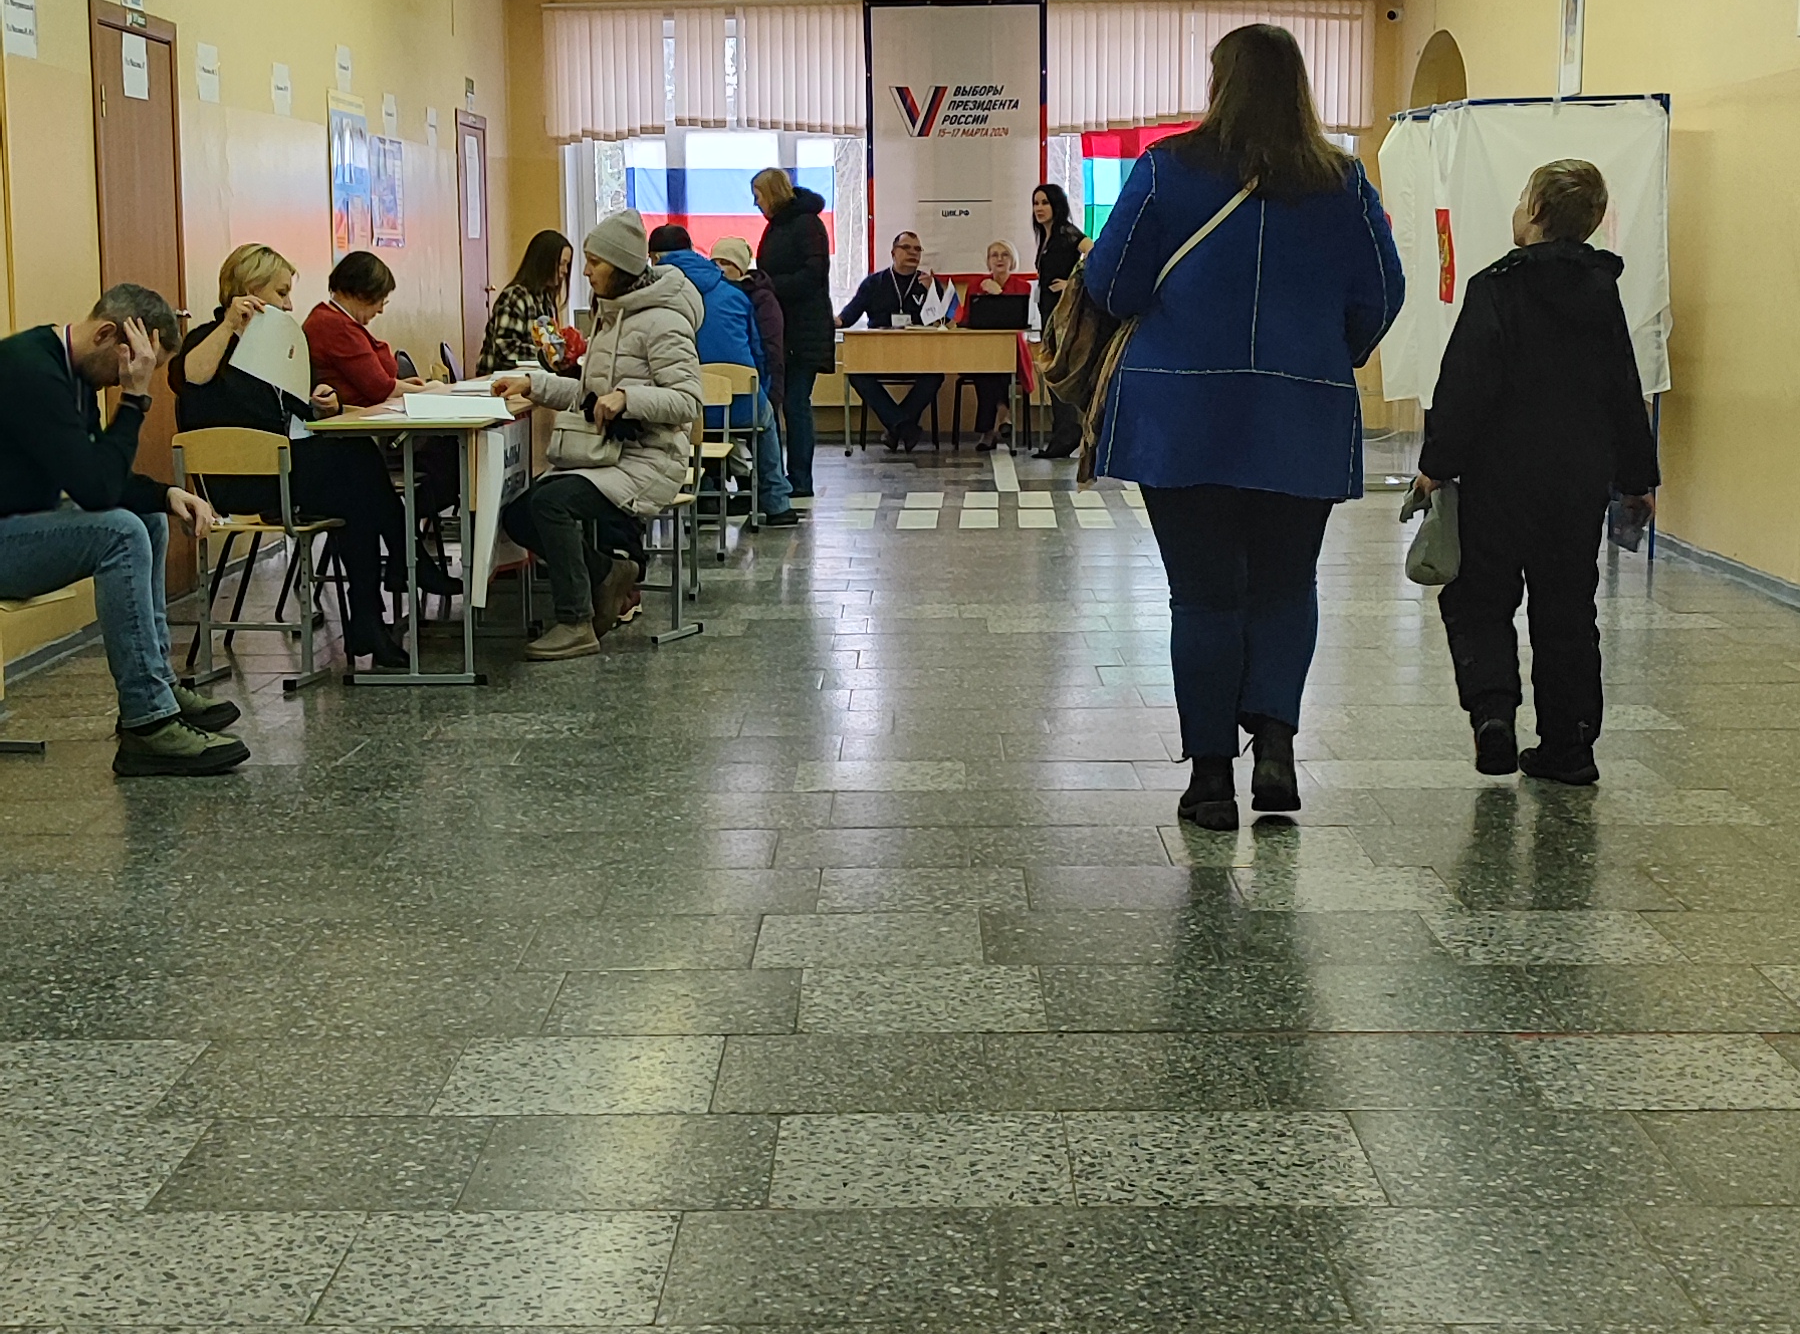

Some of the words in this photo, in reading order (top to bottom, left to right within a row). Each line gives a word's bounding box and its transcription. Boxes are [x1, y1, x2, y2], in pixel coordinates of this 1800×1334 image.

[953, 85, 1004, 97] ВЫБОРЫ
[947, 99, 1019, 112] ПРЕЗИДЕНТА
[941, 114, 988, 125] РОССИИ
[960, 128, 989, 137] МАРТА
[989, 127, 1009, 137] 2024
[941, 209, 970, 218] ЦИК.РФ
